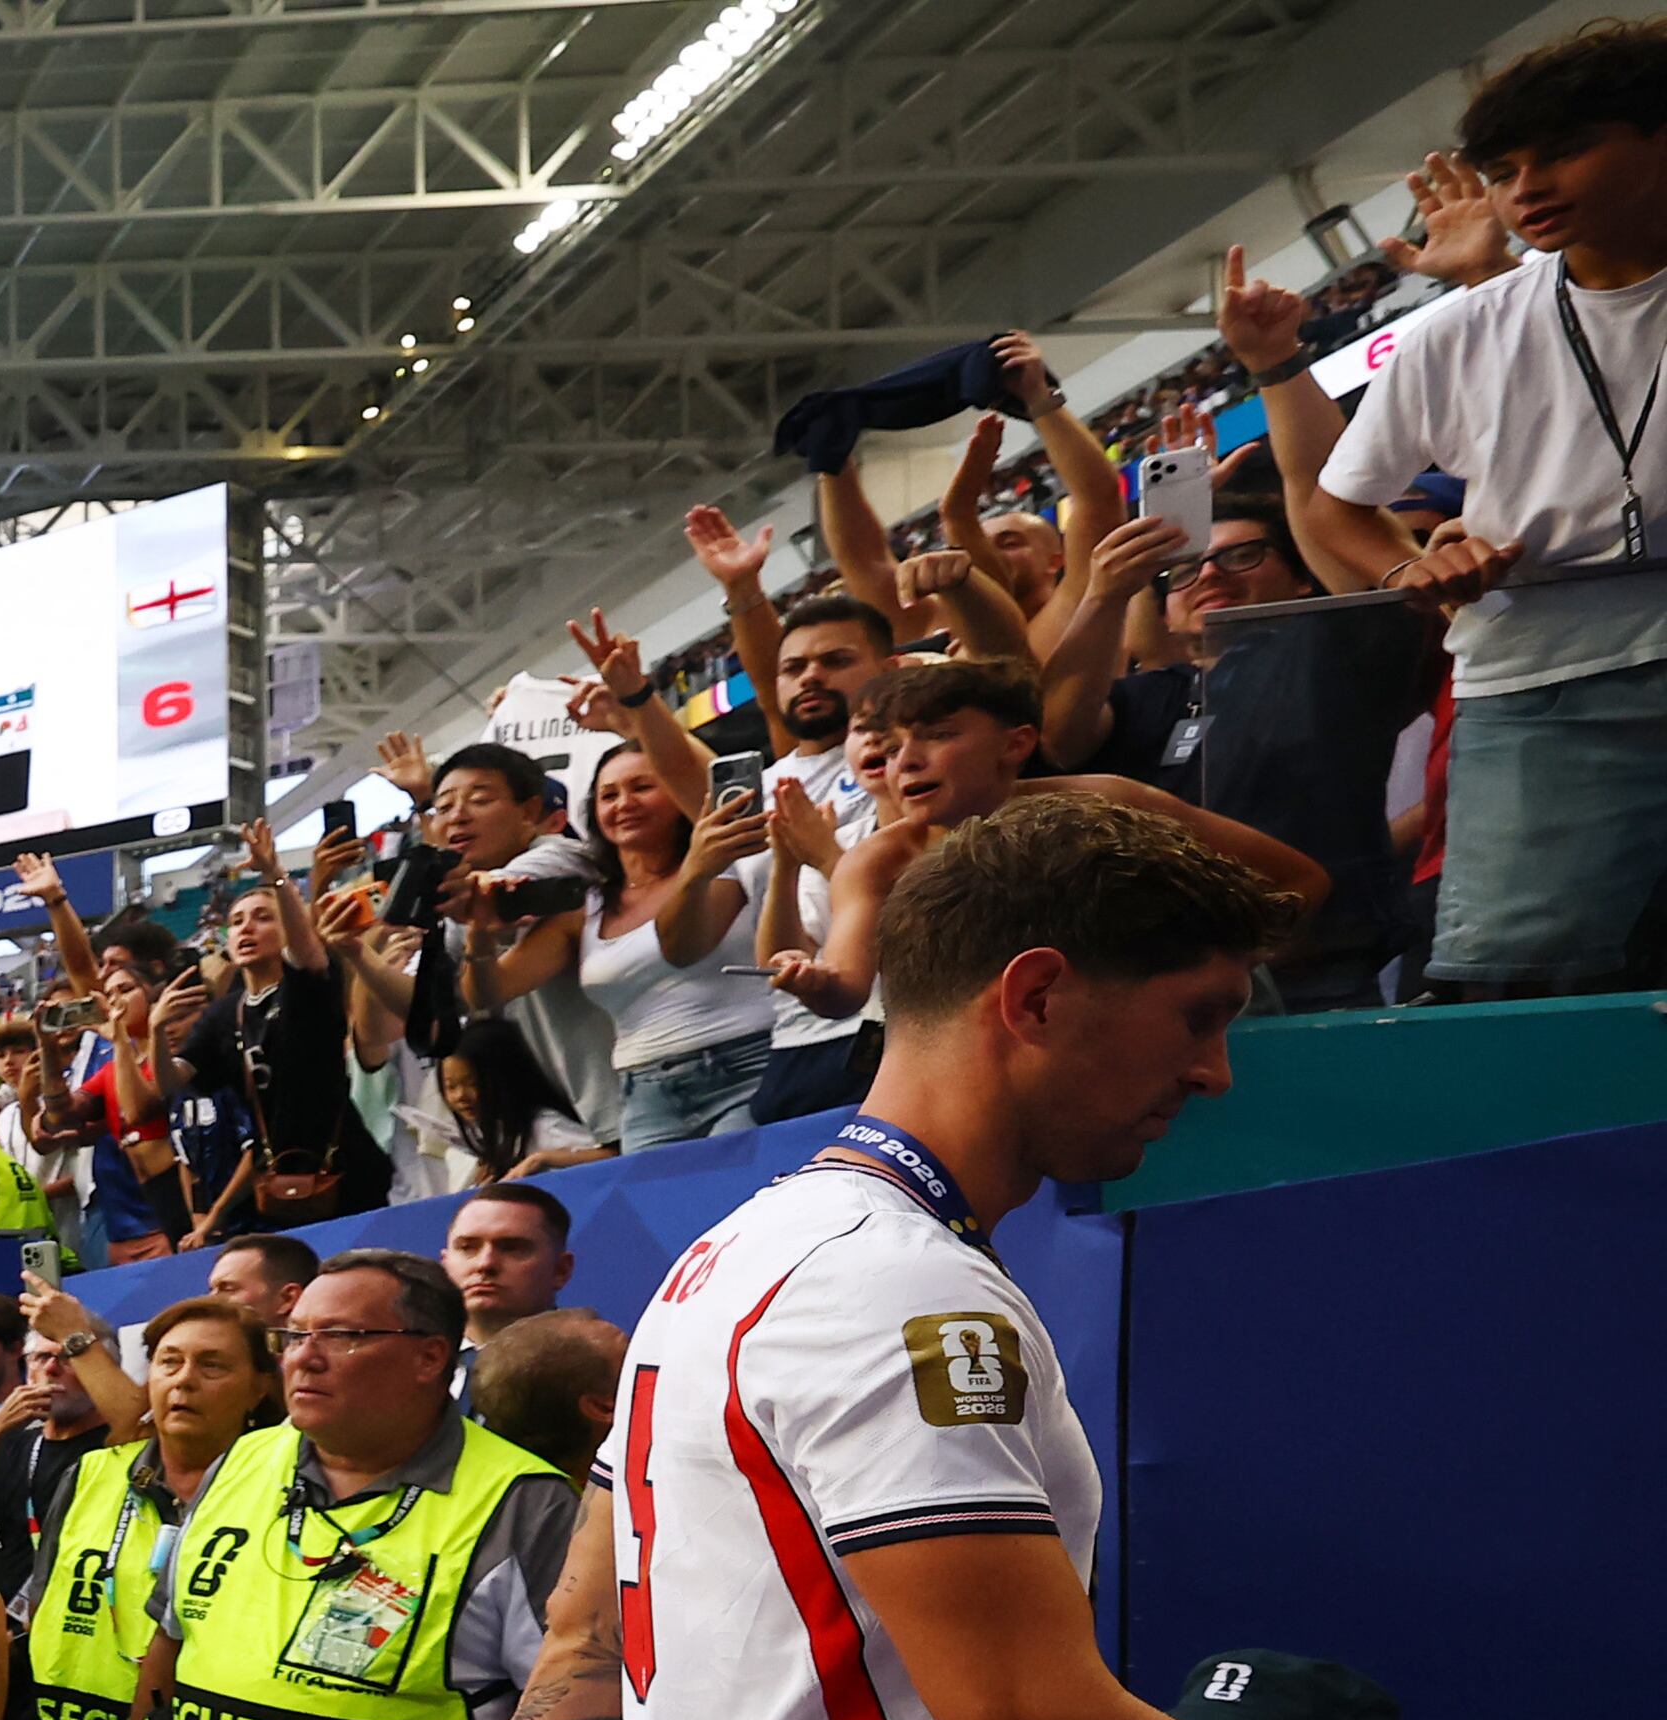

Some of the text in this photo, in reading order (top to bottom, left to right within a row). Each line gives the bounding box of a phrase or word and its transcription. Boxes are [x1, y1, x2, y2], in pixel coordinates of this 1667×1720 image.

[139, 679, 196, 730] 6
[850, 1124, 948, 1198] CUP 2026
[968, 1377, 992, 1386] FIFA
[953, 1394, 989, 1404] WORLD
[955, 1403, 1007, 1416] 2026
